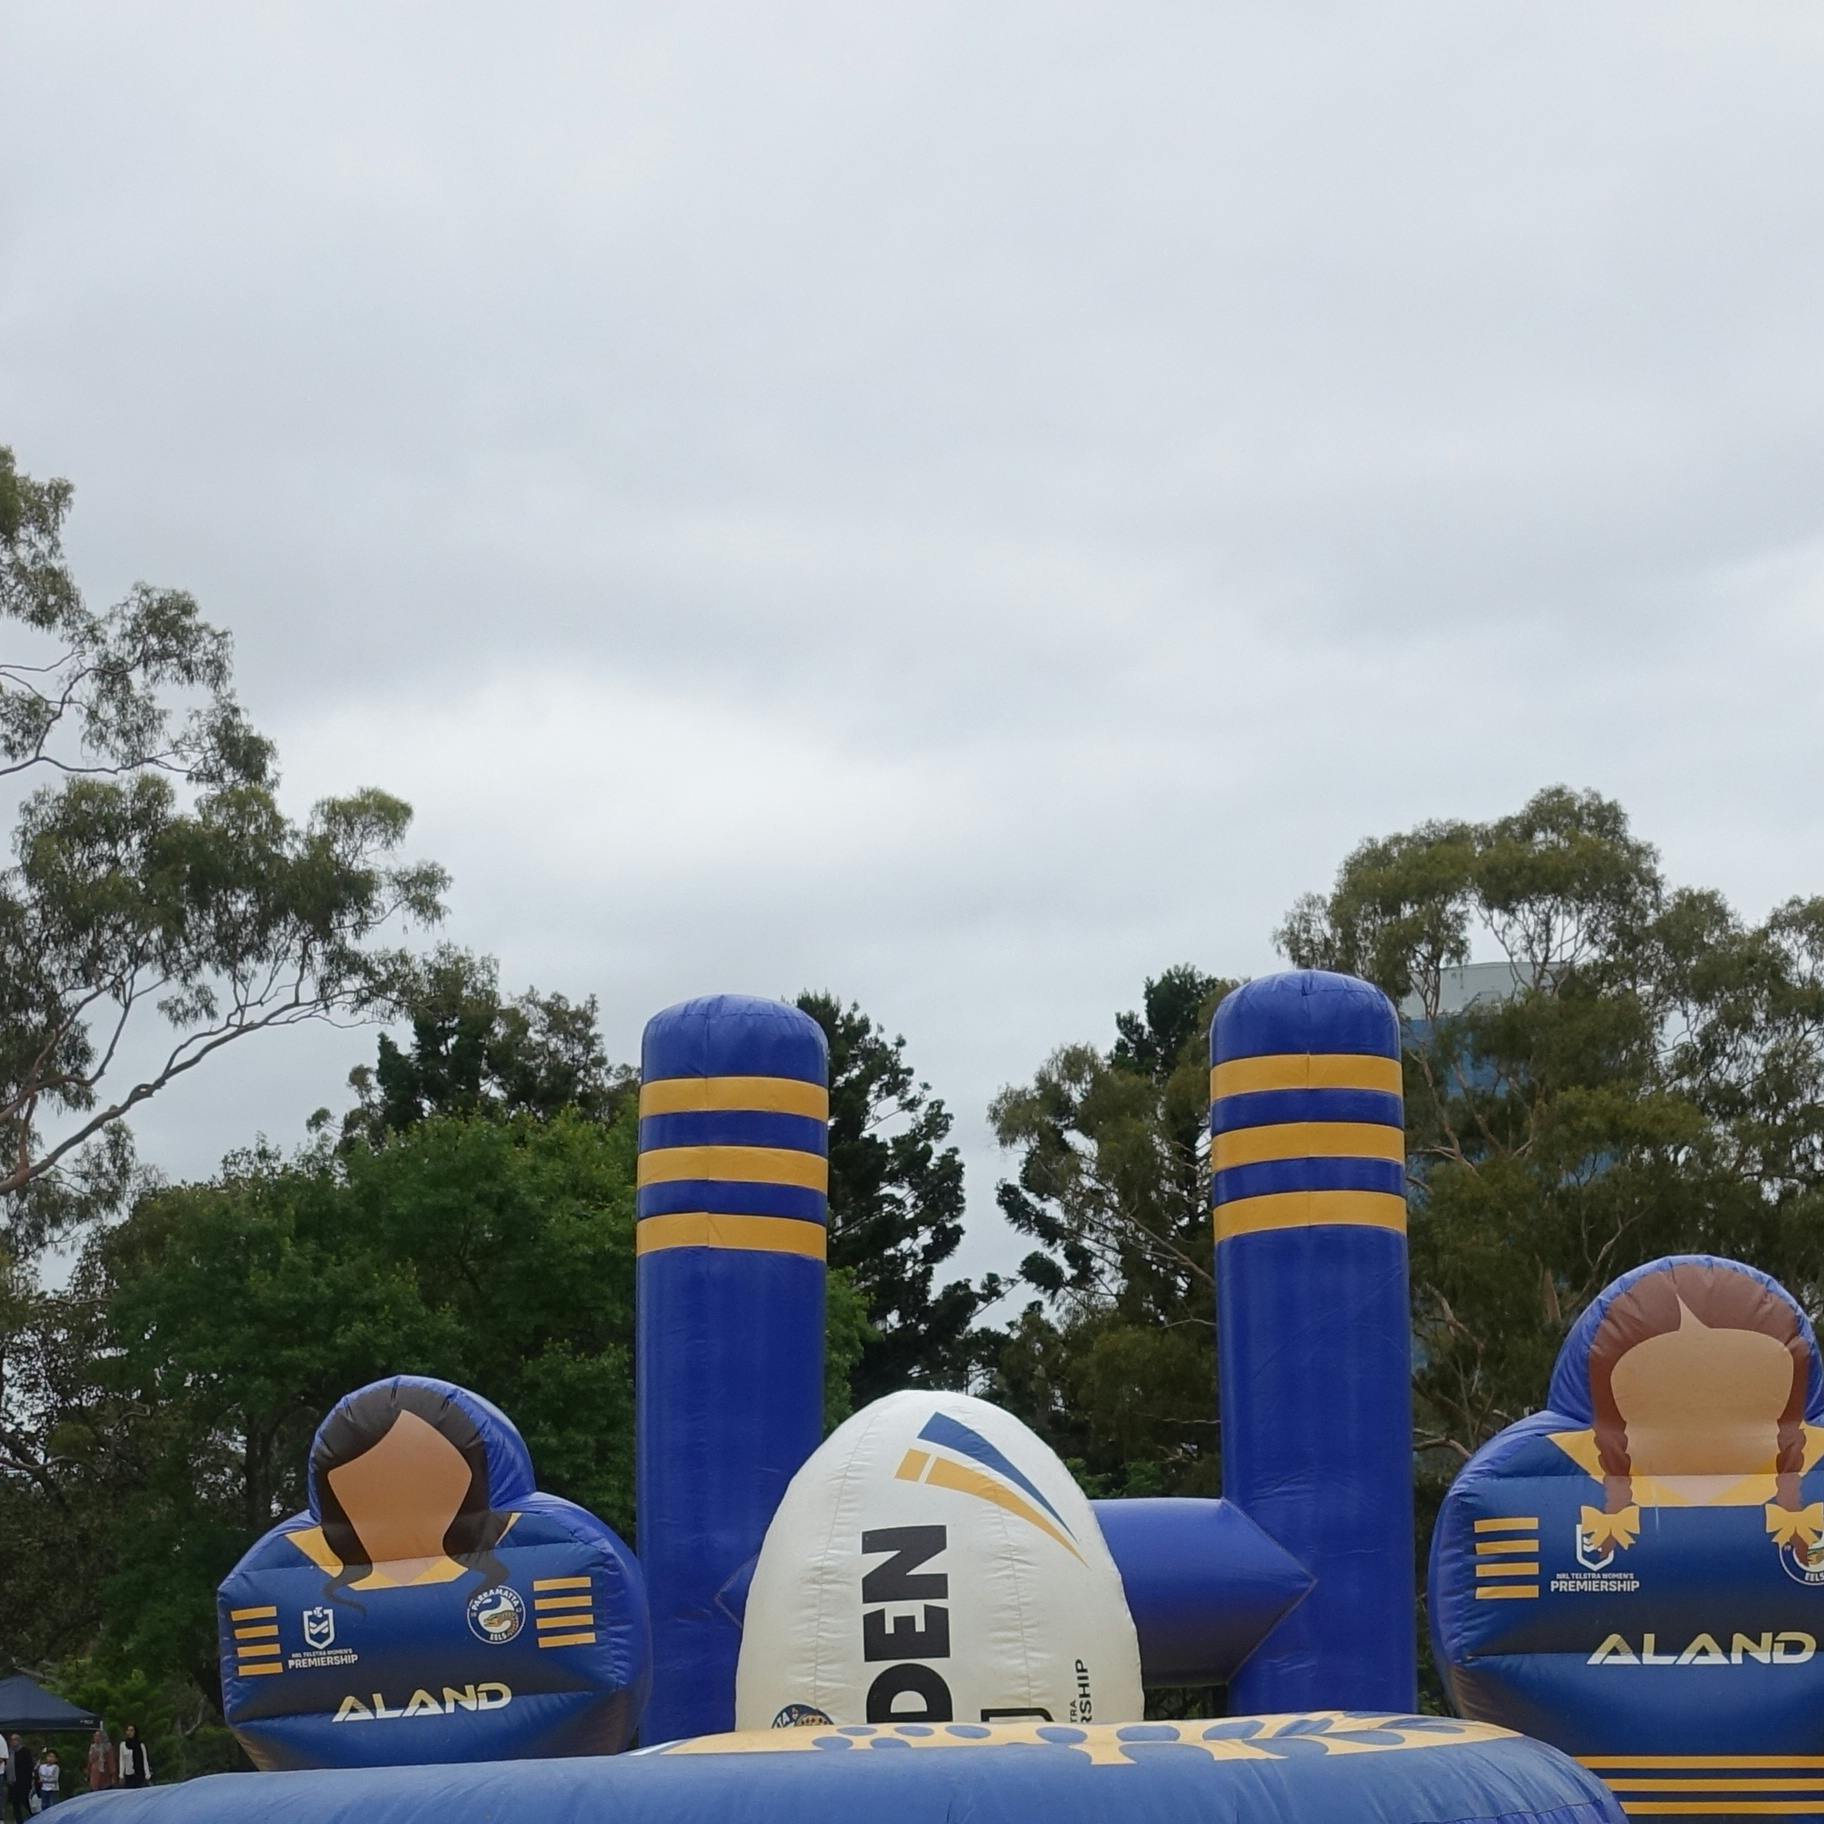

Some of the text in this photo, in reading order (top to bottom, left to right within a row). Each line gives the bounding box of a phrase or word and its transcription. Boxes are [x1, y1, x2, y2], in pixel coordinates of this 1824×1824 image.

[1550, 1580, 1641, 1593] PREMIERSHIP
[1586, 1631, 1817, 1665] ALAND
[288, 1654, 359, 1670] PREMIERSHIP
[331, 1682, 513, 1723] ALAND
